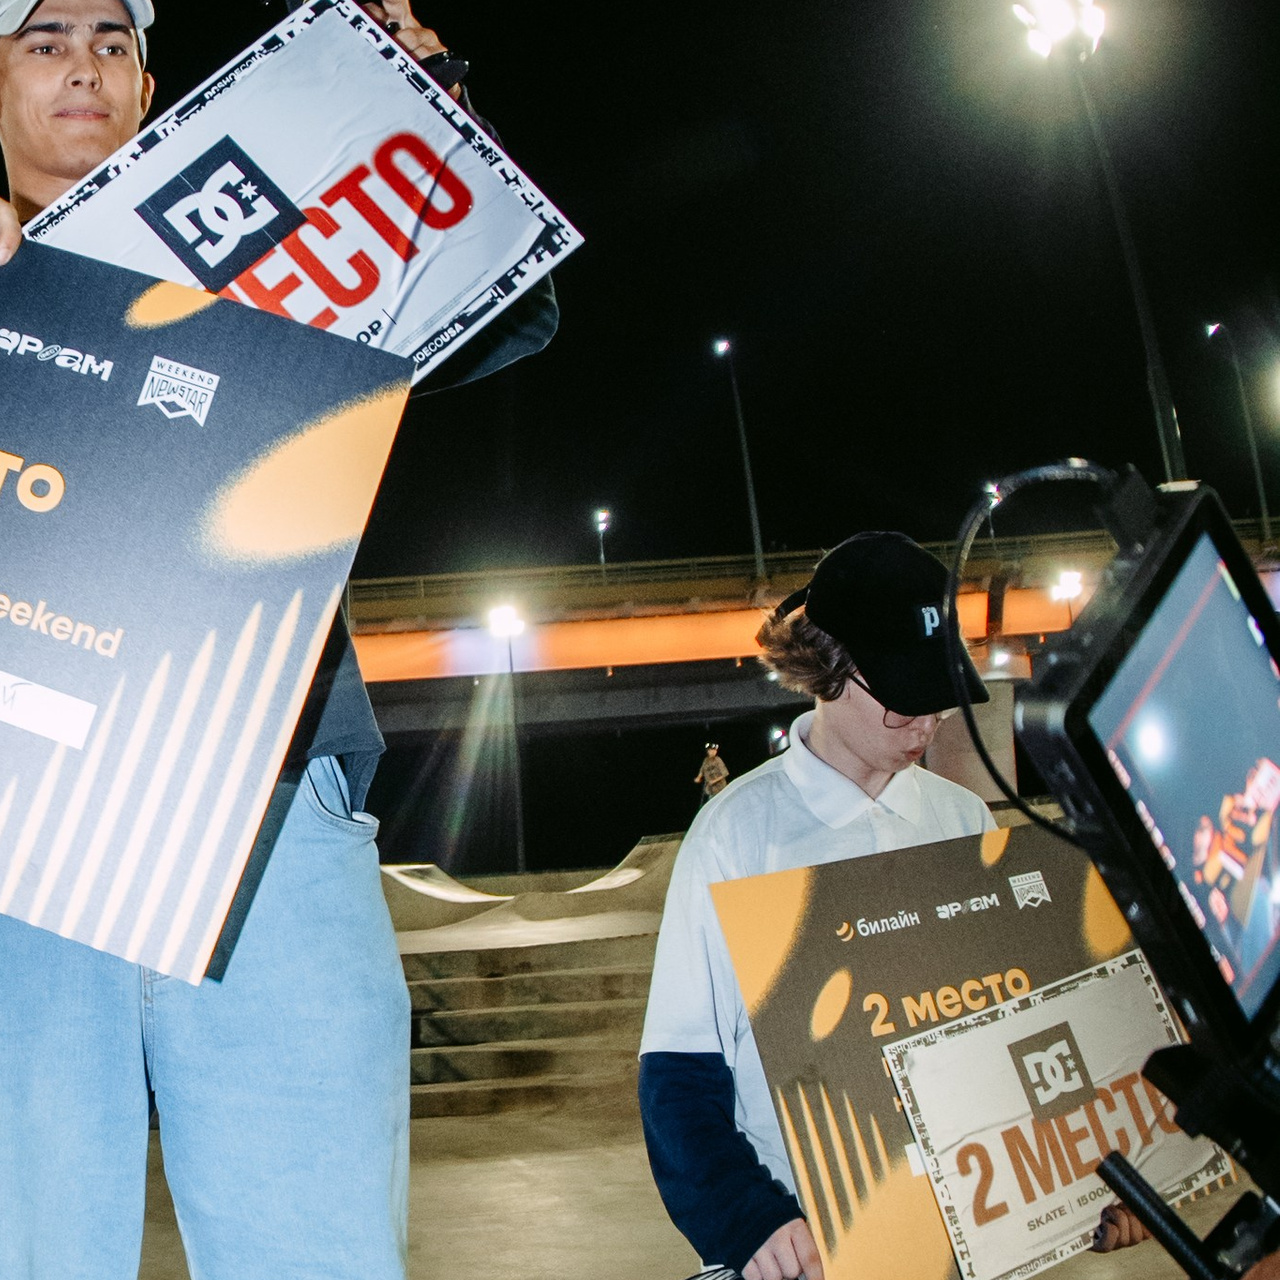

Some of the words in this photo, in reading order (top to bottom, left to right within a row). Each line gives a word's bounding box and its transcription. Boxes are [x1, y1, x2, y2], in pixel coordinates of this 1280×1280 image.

[219, 130, 475, 331] ЕСТО
[156, 361, 214, 385] WEEKEND
[856, 910, 921, 937] билайн
[862, 992, 896, 1037] 2
[901, 968, 1031, 1028] место
[955, 1141, 1010, 1227] 2
[1027, 1205, 1067, 1231] SKATE
